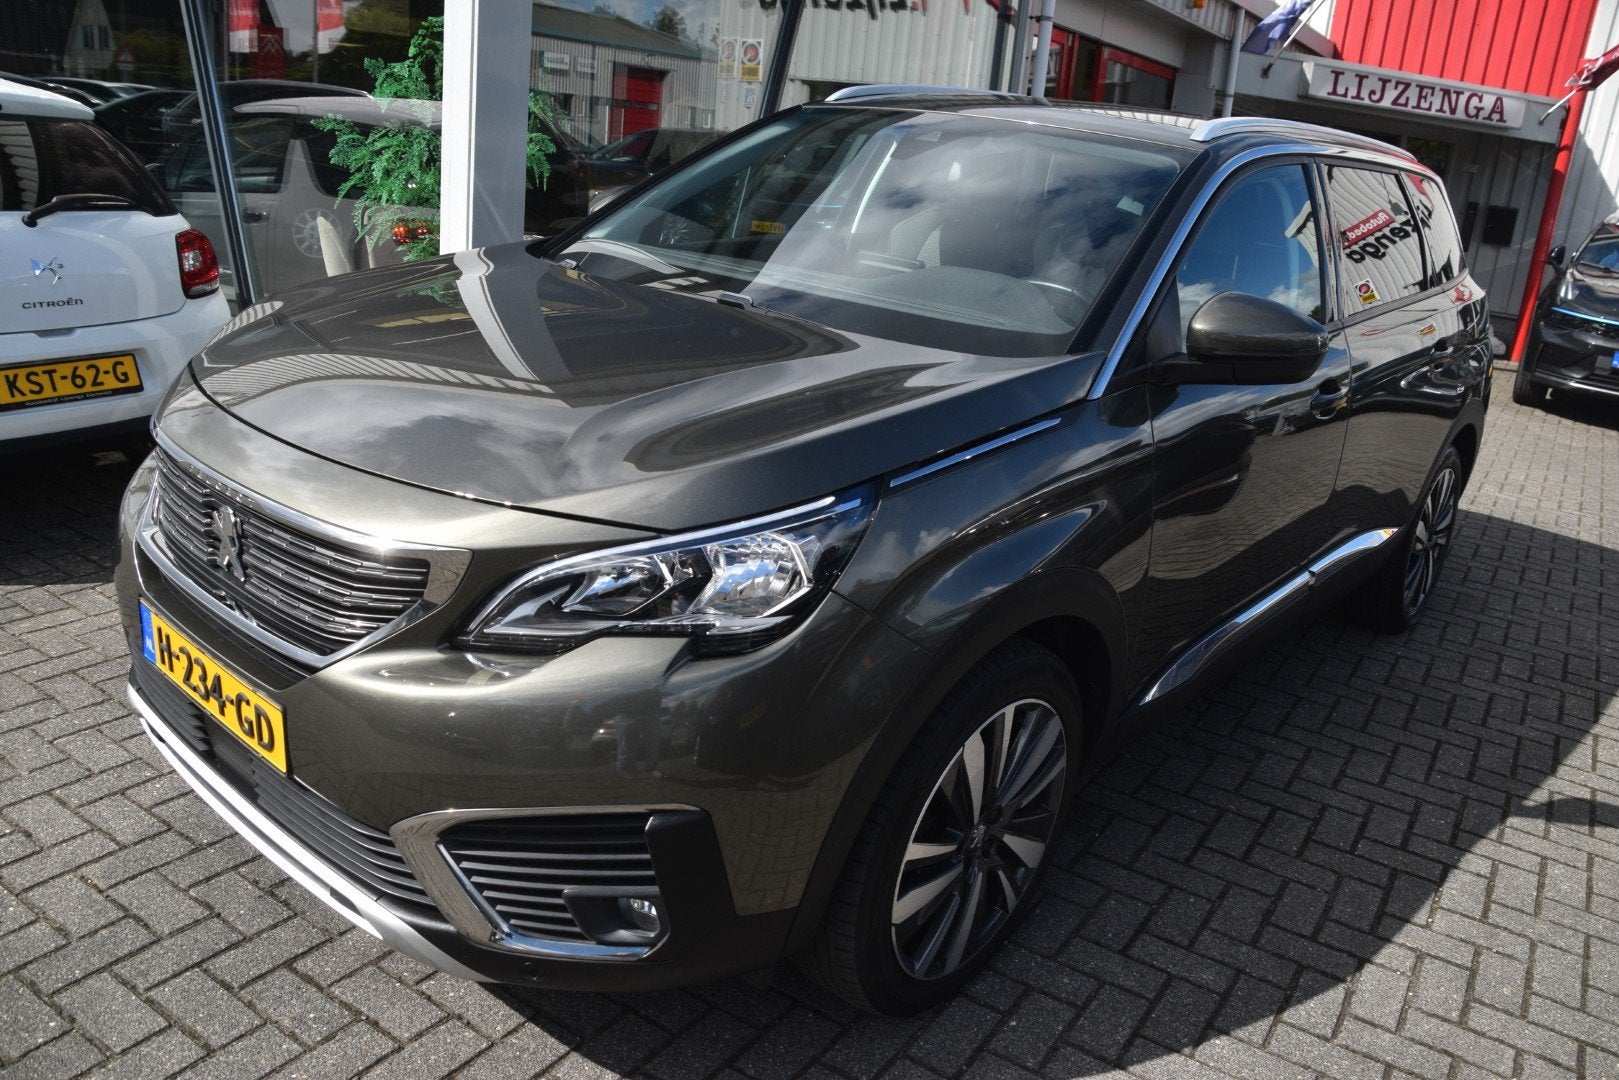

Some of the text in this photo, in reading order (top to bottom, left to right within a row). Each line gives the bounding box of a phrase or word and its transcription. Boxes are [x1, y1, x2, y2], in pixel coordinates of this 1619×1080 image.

[1327, 69, 1507, 124] LIJZENGA
[4, 360, 130, 399] KST-62-G
[156, 625, 275, 753] H-234-GD
